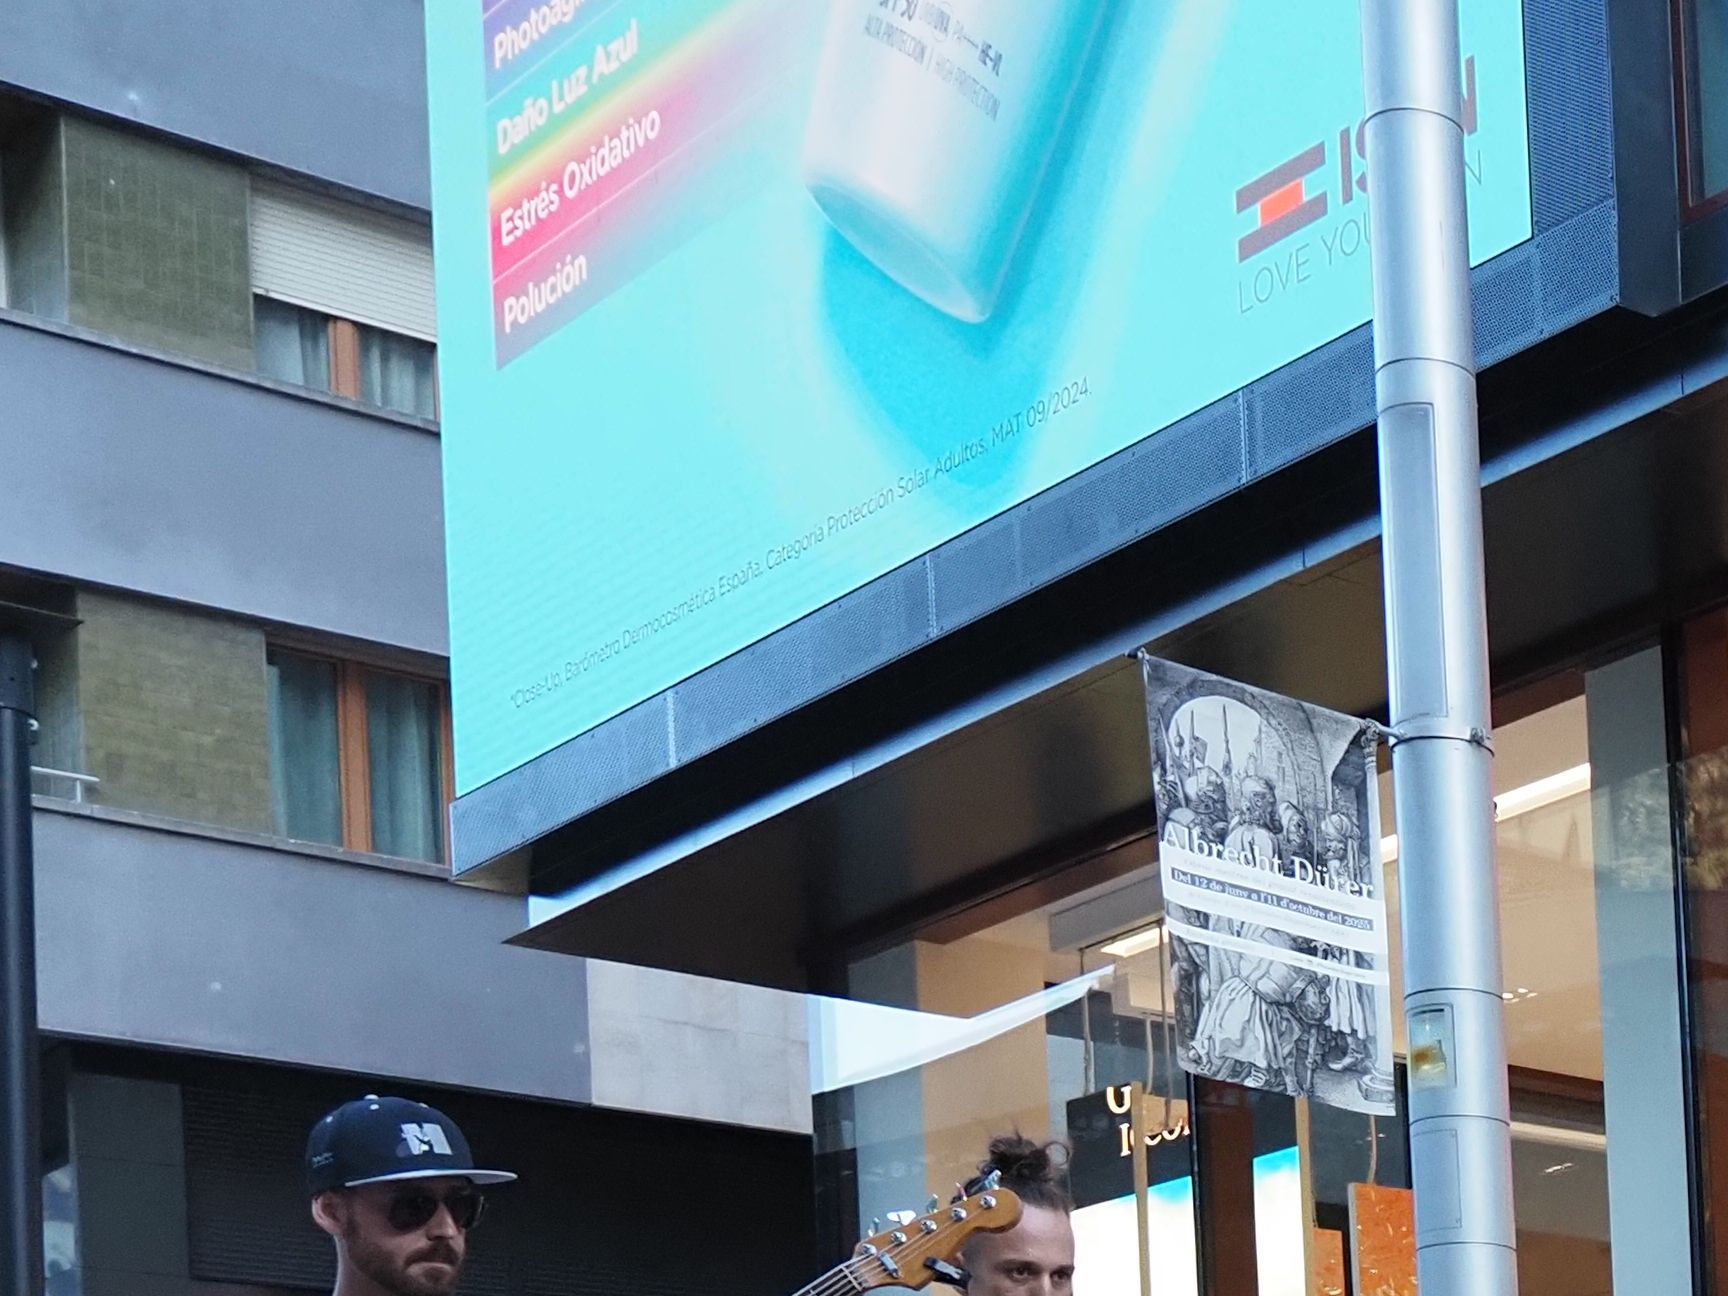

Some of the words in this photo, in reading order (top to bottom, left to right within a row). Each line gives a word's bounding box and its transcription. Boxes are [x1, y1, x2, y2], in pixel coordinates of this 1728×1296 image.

[497, 96, 548, 154] Daño
[551, 65, 589, 114] Luz
[592, 17, 639, 84] Azul
[501, 181, 560, 247] Estrés
[563, 110, 661, 199] Oxidativo
[504, 254, 588, 334] Polución
[1239, 243, 1312, 314] LOVE
[623, 586, 716, 649] Dermocosmética
[766, 524, 825, 570] Categoría
[827, 488, 894, 536] Protección
[898, 467, 930, 498] Solar
[991, 411, 1022, 447] MAT
[1026, 376, 1092, 427] 09/2024.
[1162, 820, 1283, 876] Albrecht
[1291, 855, 1374, 900] Dürer
[1174, 868, 1192, 884] Del
[1195, 877, 1208, 889] 12
[1209, 880, 1223, 891] de
[1280, 898, 1326, 919] d'octubre
[1327, 911, 1343, 925] del
